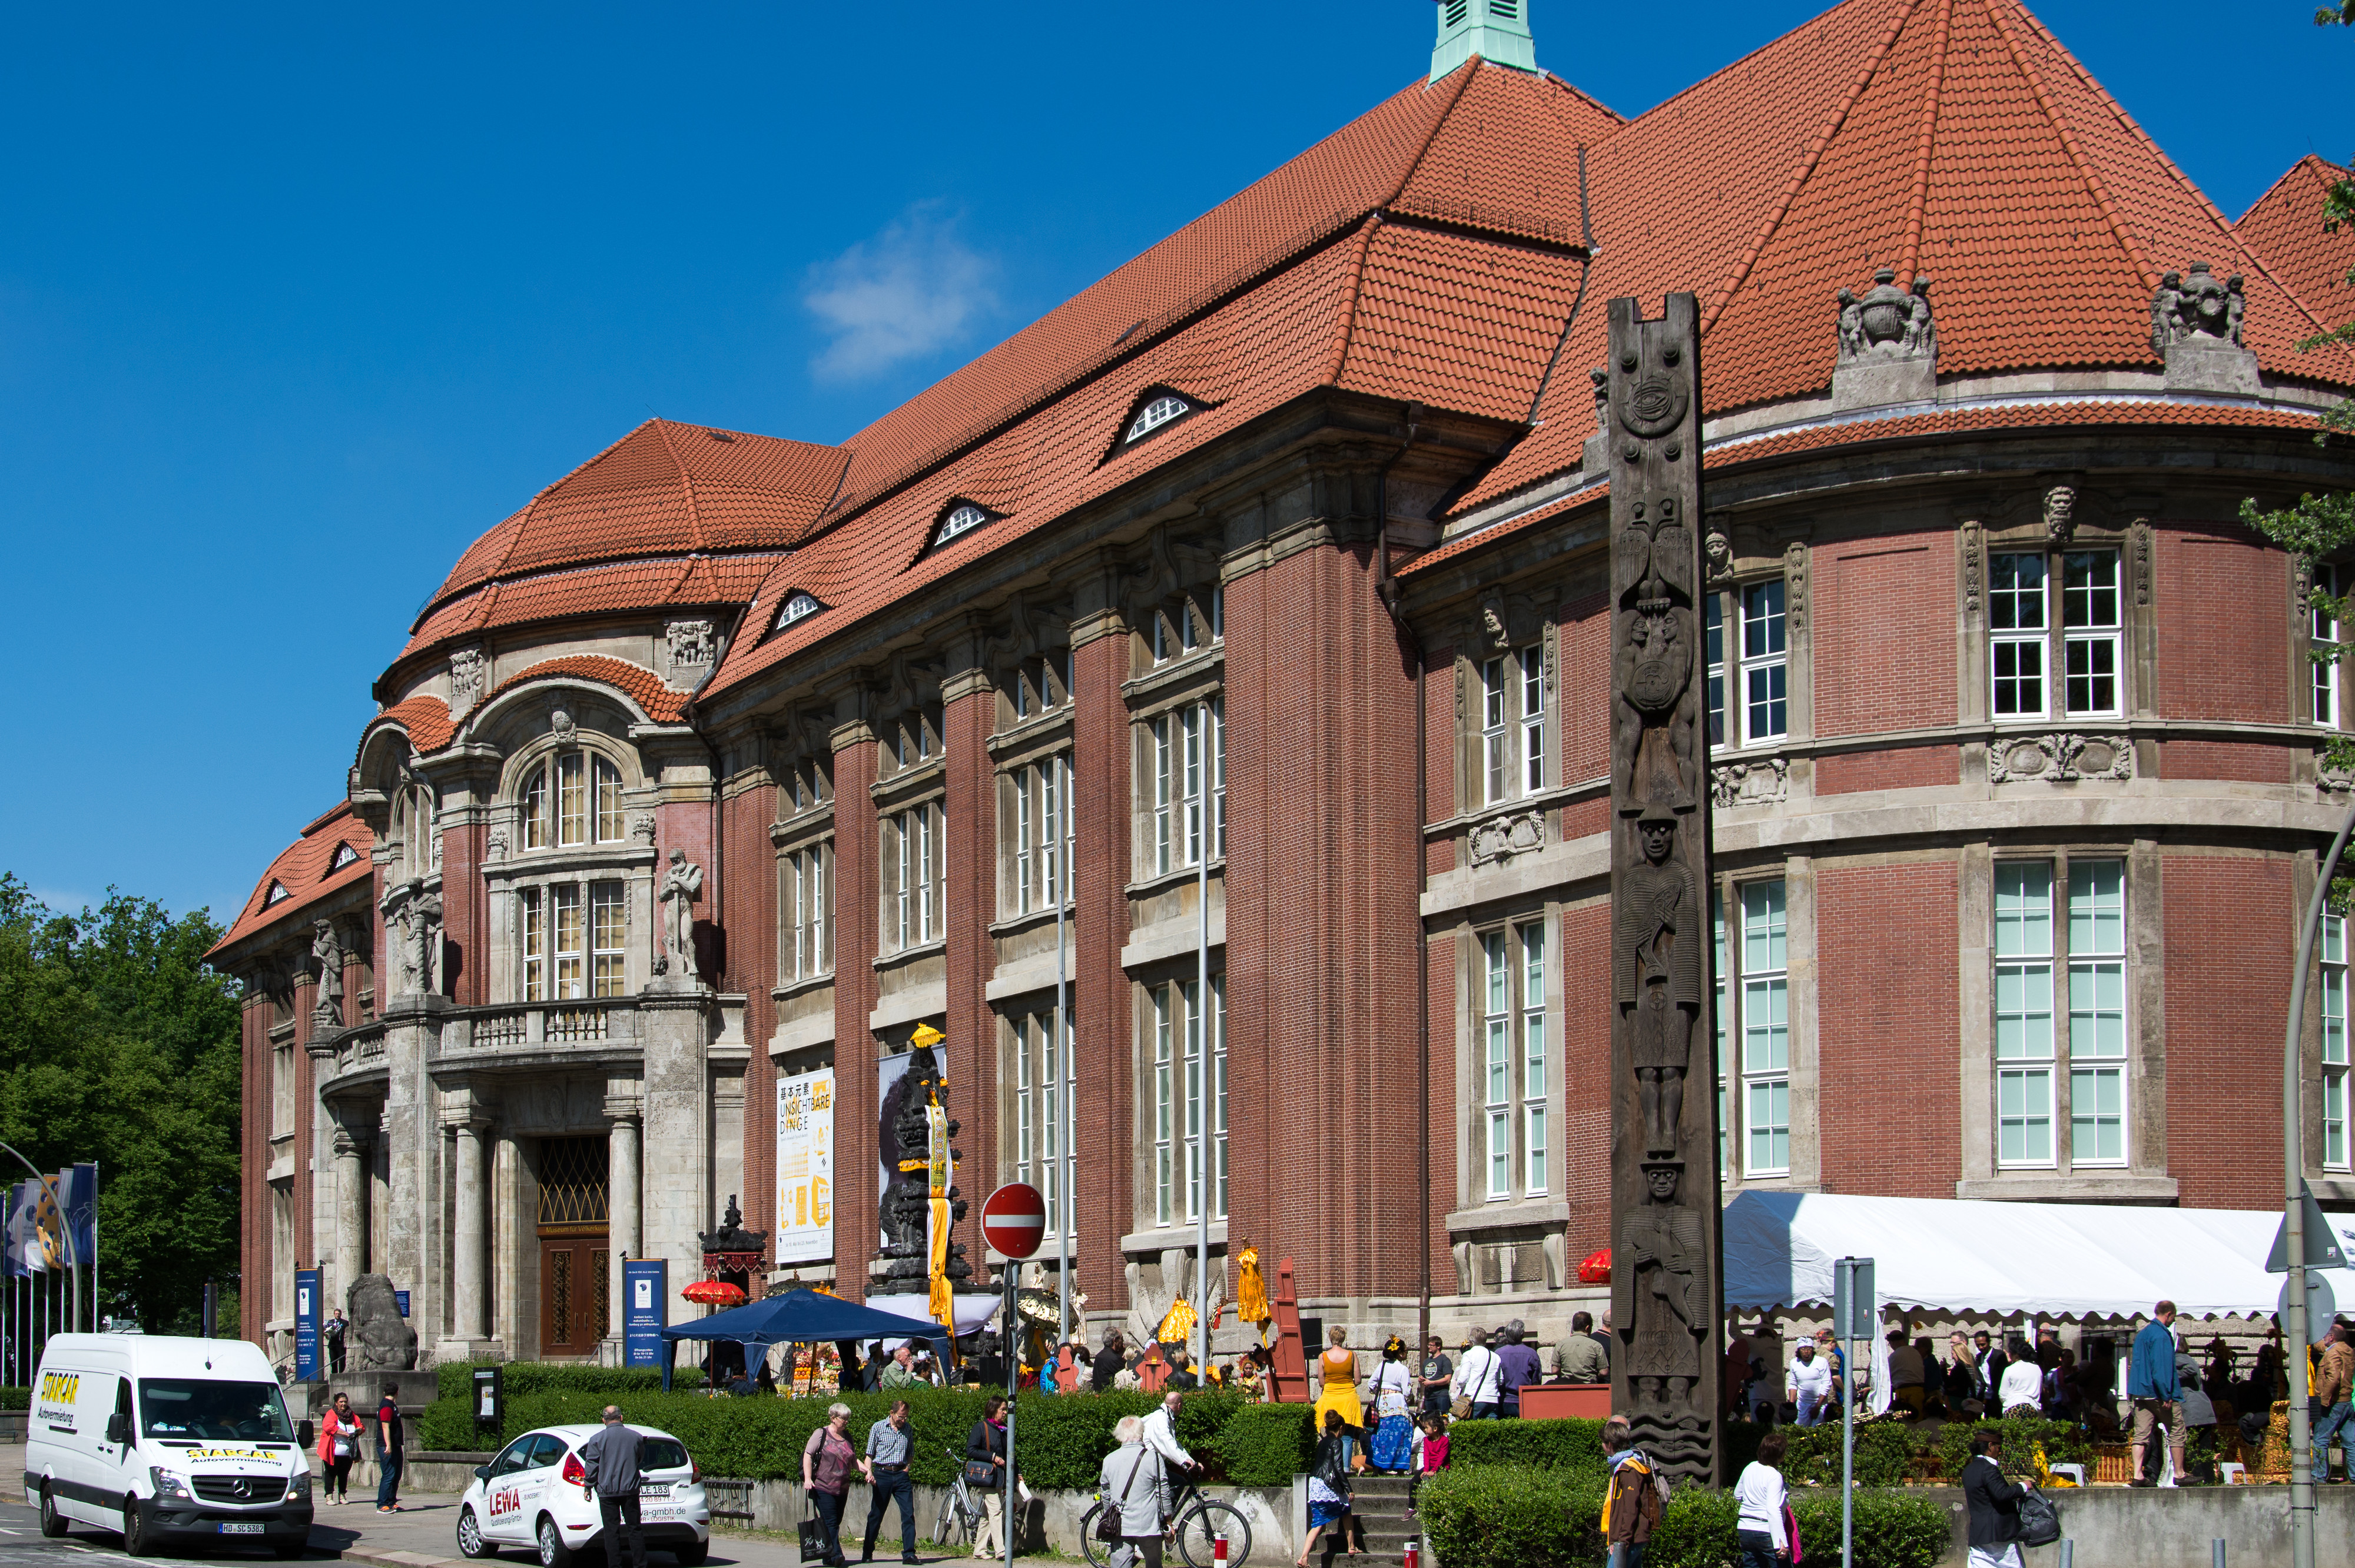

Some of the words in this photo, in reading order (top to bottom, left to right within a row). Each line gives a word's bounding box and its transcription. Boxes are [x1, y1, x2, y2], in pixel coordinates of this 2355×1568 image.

[781, 1082, 809, 1100] 基本元素
[780, 1094, 829, 1117] UNSICHTBARE
[780, 1116, 808, 1134] DINGE
[41, 1371, 79, 1405] STARCAR
[38, 1406, 74, 1427] Autovermietung
[186, 1449, 281, 1461] STARCAR
[191, 1457, 282, 1467] Autovermietung
[653, 1486, 668, 1494] 183
[490, 1488, 520, 1516] LEWA
